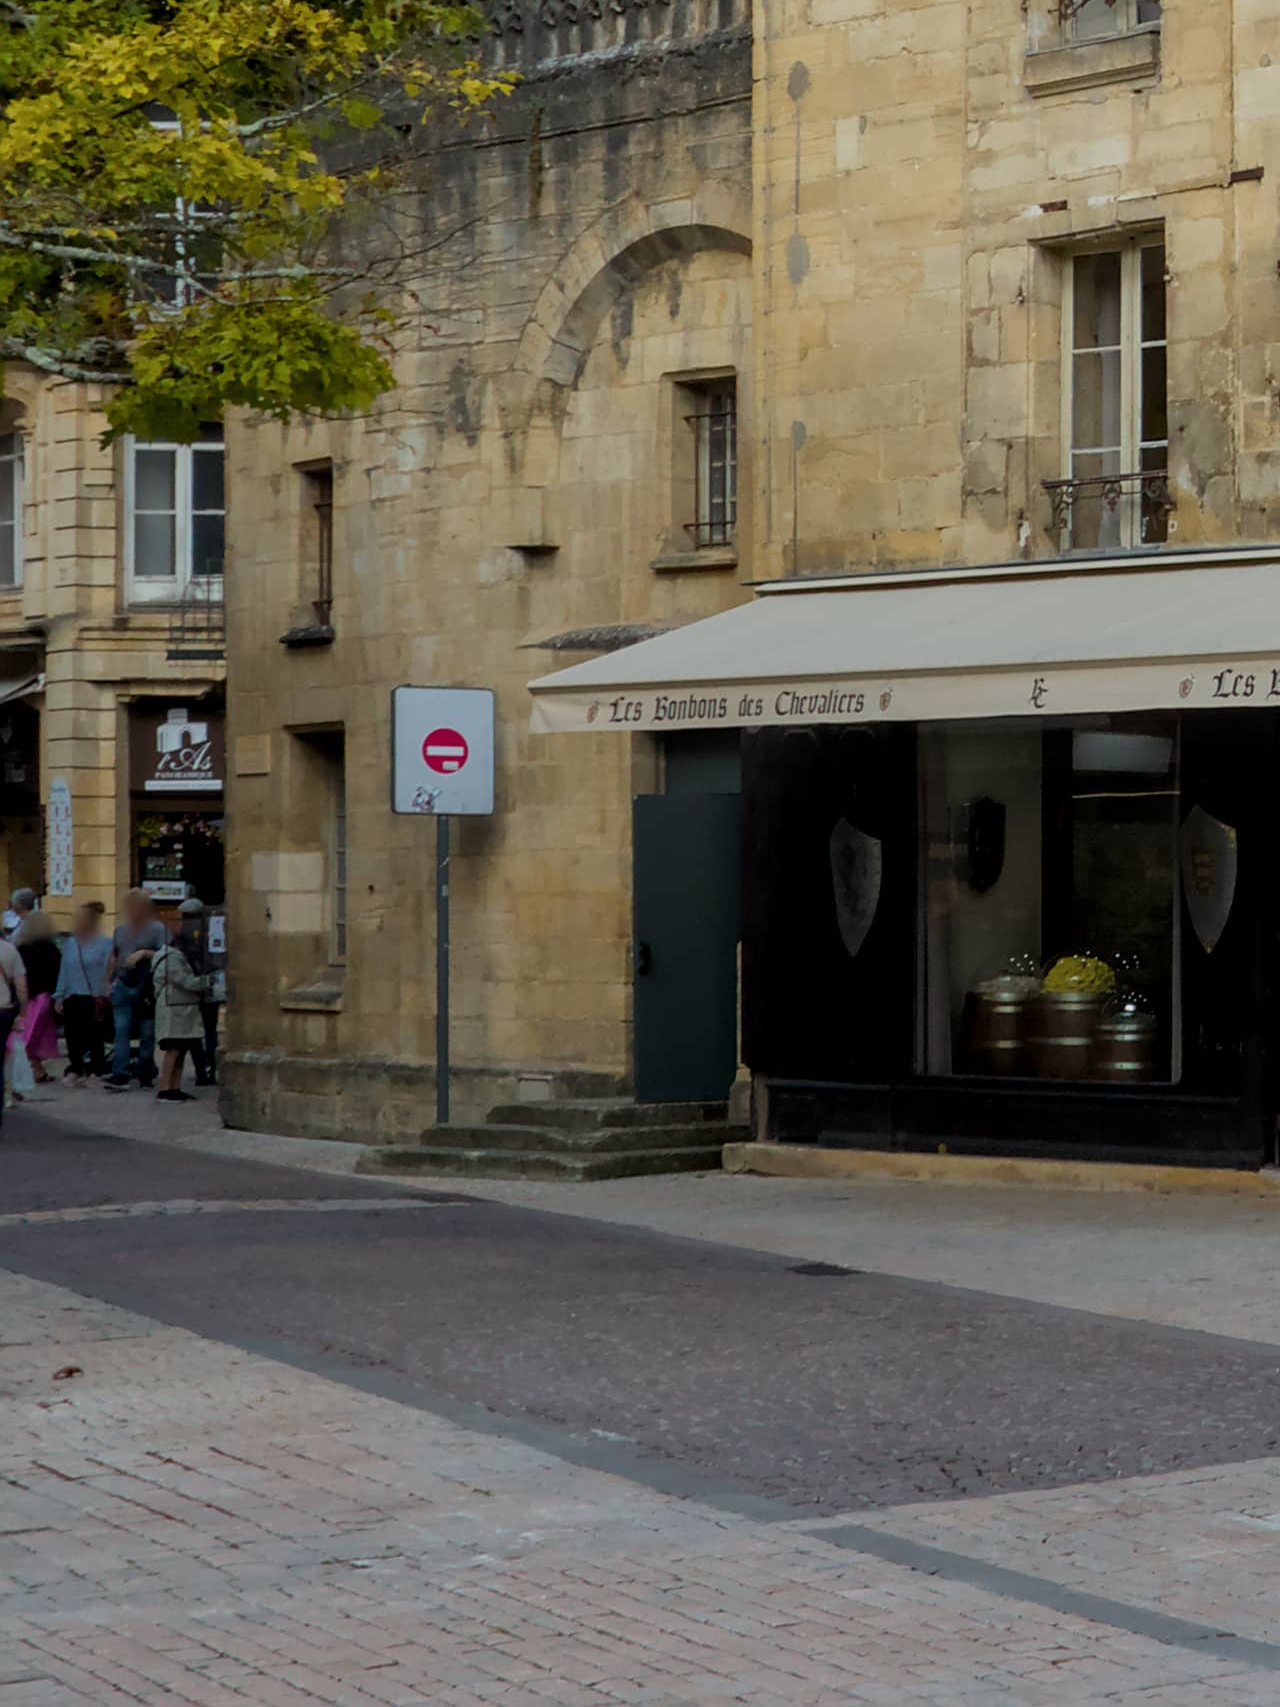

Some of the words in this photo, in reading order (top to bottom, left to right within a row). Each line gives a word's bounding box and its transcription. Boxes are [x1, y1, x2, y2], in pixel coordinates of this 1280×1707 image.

[1211, 668, 1256, 699] Les
[608, 696, 643, 723] Les
[653, 694, 728, 722] Bonbons
[738, 693, 764, 717] des
[774, 689, 865, 716] Chevaliers
